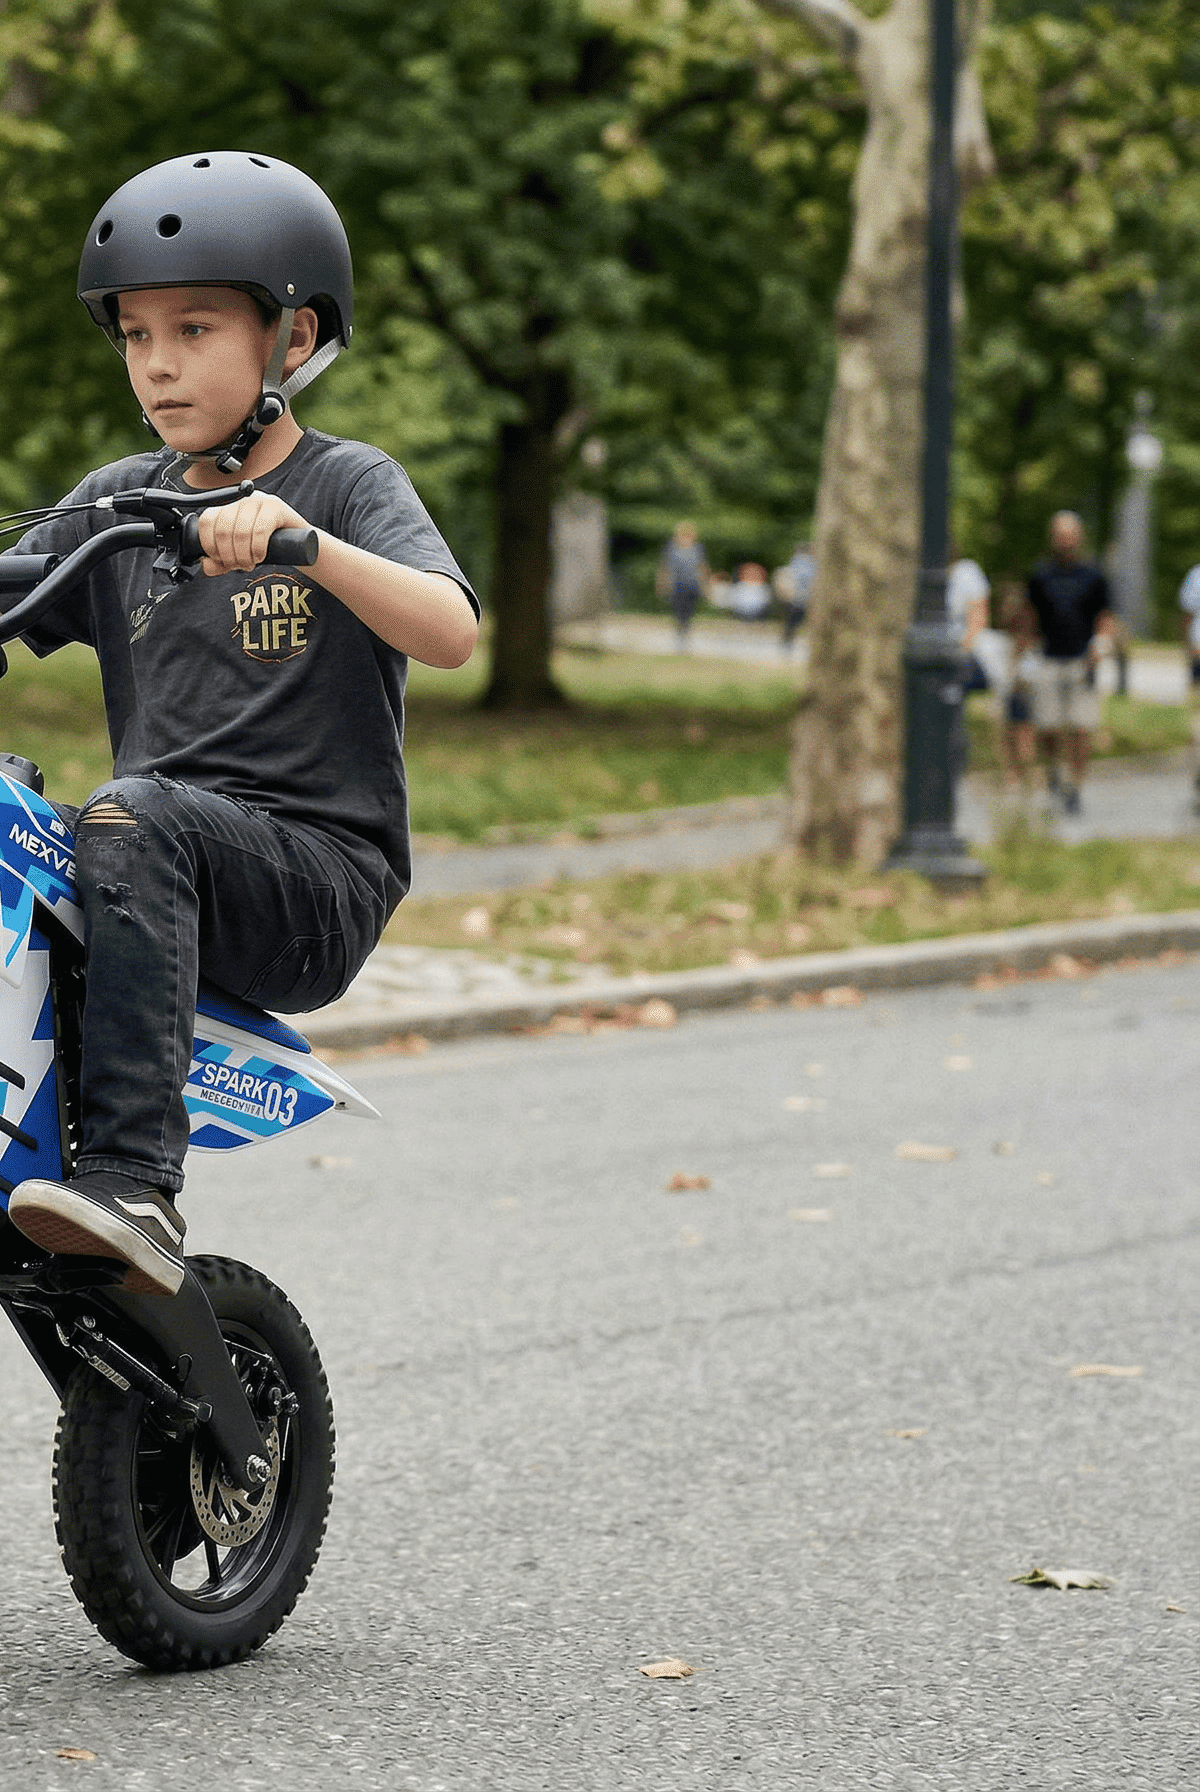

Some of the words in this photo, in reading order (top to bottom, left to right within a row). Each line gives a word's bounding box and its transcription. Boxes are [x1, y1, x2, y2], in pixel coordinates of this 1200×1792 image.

[230, 584, 313, 624] PARK
[242, 617, 308, 651] LIFE
[201, 1062, 269, 1102] SPARK
[263, 1081, 299, 1127] 03
